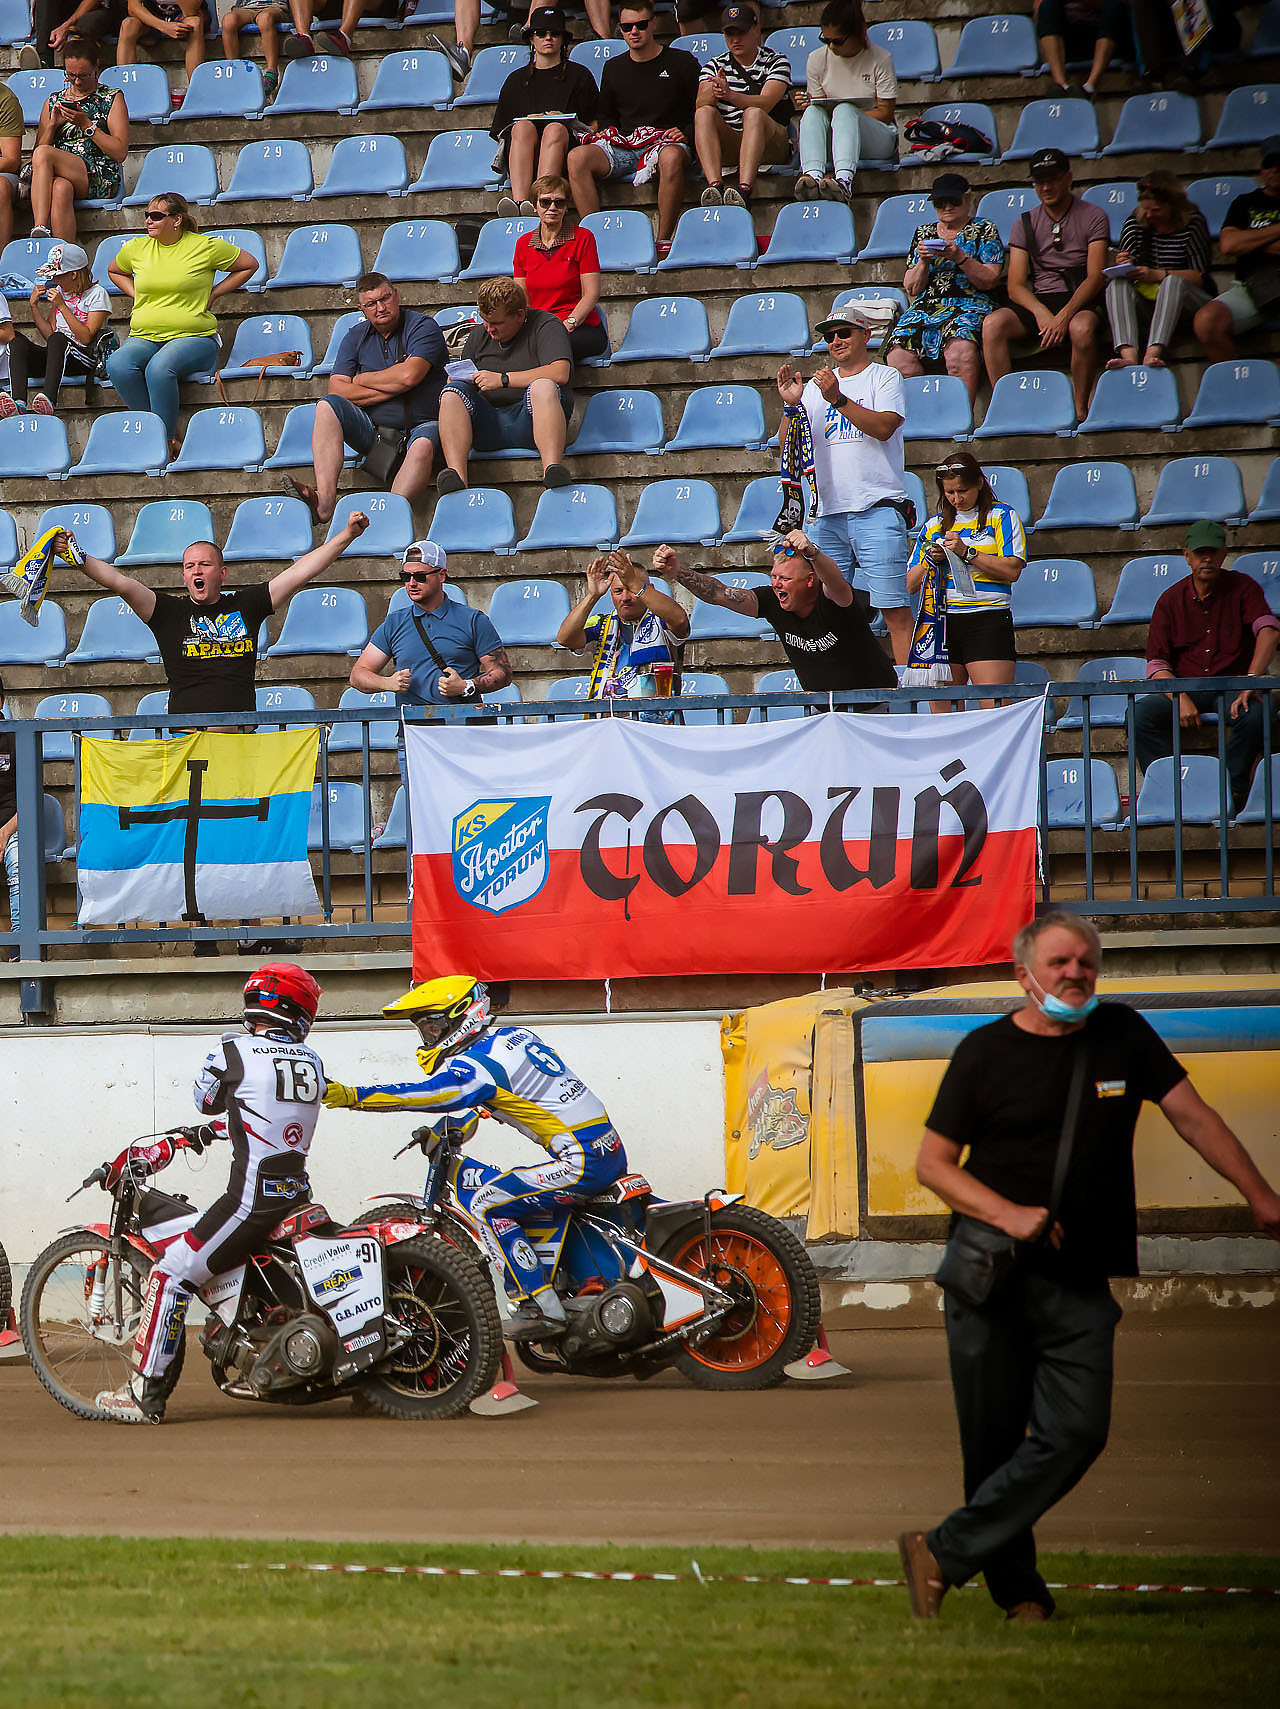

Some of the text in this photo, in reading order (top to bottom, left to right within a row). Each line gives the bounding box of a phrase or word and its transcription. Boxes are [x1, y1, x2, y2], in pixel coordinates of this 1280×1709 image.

[992, 20, 1008, 33] 22
[888, 28, 903, 40] 23
[692, 40, 707, 52] 25
[790, 35, 806, 48] 24
[500, 52, 516, 63] 27
[595, 46, 609, 58] 26
[312, 61, 327, 72] 29
[403, 58, 417, 70] 28
[123, 71, 136, 82] 31
[215, 67, 232, 78] 30
[30, 77, 45, 88] 32
[1049, 105, 1060, 117] 21
[360, 141, 376, 152] 28
[455, 135, 472, 147] 27
[168, 152, 183, 163] 30
[264, 146, 281, 157] 29
[908, 201, 924, 212] 22
[1008, 195, 1024, 207] 21
[704, 210, 719, 222] 24
[803, 207, 819, 218] 23
[408, 226, 426, 238] 27
[506, 222, 523, 234] 26
[312, 231, 327, 242] 28
[27, 242, 40, 253] 31
[660, 302, 676, 316] 24
[758, 298, 774, 310] 23
[263, 320, 285, 333] 28
[1234, 367, 1248, 379] 18
[1131, 372, 1147, 387] 19
[923, 380, 939, 392] 21
[619, 398, 633, 410] 24
[716, 392, 733, 404] 23
[220, 412, 234, 424] 28
[18, 420, 37, 432] 30
[123, 421, 141, 433] 29
[1087, 470, 1100, 482] 19
[1194, 464, 1208, 477] 18
[572, 491, 586, 503] 24
[676, 487, 690, 499] 23
[370, 499, 385, 511] 26
[469, 493, 484, 506] 25
[170, 509, 184, 520] 28
[265, 503, 283, 515] 27
[73, 513, 89, 524] 29
[1154, 564, 1167, 576] 18
[1263, 561, 1278, 574] 17
[1044, 569, 1058, 581] 19
[524, 586, 539, 598] 24
[322, 594, 336, 606] 26
[186, 639, 254, 657] APATOR
[784, 677, 797, 690] 21
[266, 692, 282, 705] 26
[60, 700, 78, 712] 28
[1063, 770, 1077, 783] 18
[458, 814, 487, 847] KS
[573, 758, 989, 921] TORUŃ
[460, 805, 546, 893] Apator
[528, 1045, 561, 1073] 5
[275, 1060, 318, 1103] 13
[356, 1243, 377, 1263] #91
[323, 1272, 355, 1291] REALL
[335, 1296, 382, 1323] G.B. AUTO
